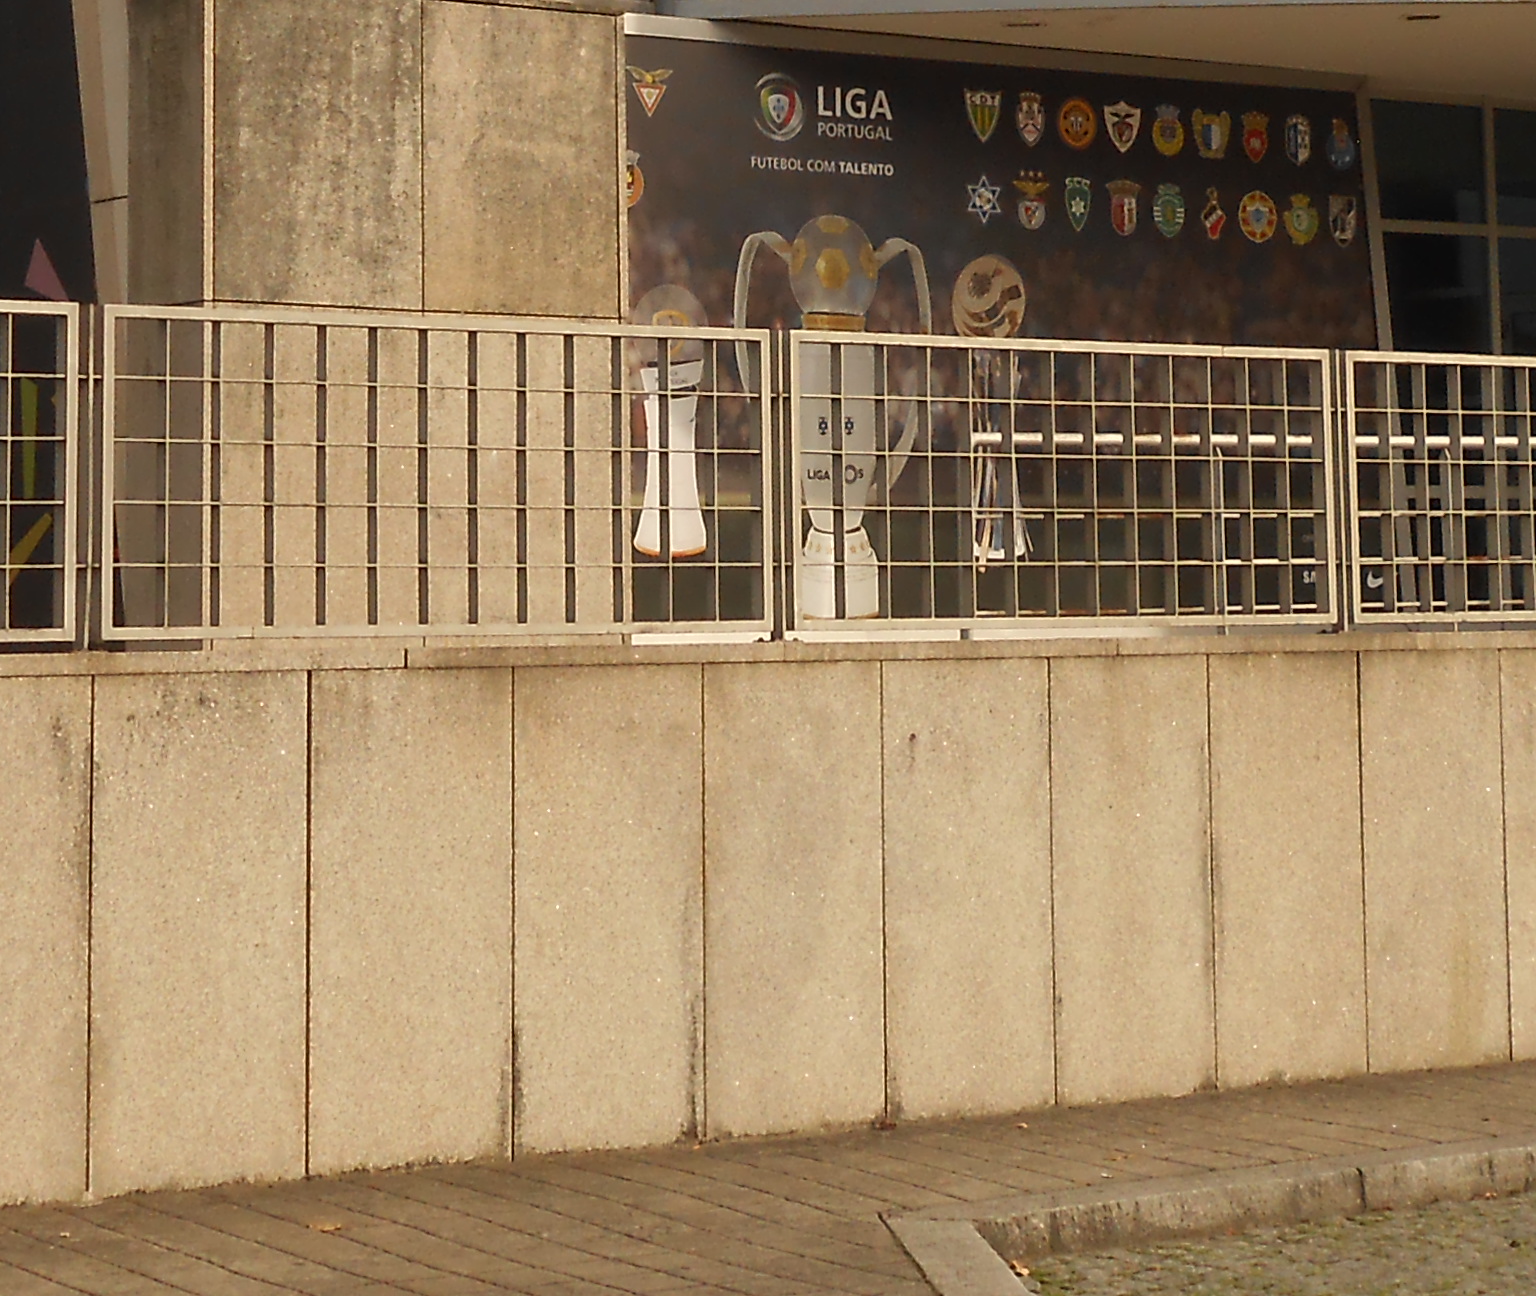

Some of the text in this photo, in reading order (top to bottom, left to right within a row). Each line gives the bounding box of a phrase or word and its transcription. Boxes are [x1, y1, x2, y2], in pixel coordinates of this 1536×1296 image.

[816, 85, 894, 121] LIGA
[817, 122, 894, 142] PORTUGAL
[751, 155, 895, 177] FUTEBOL COM TALENTO
[807, 468, 831, 481] LIGA
